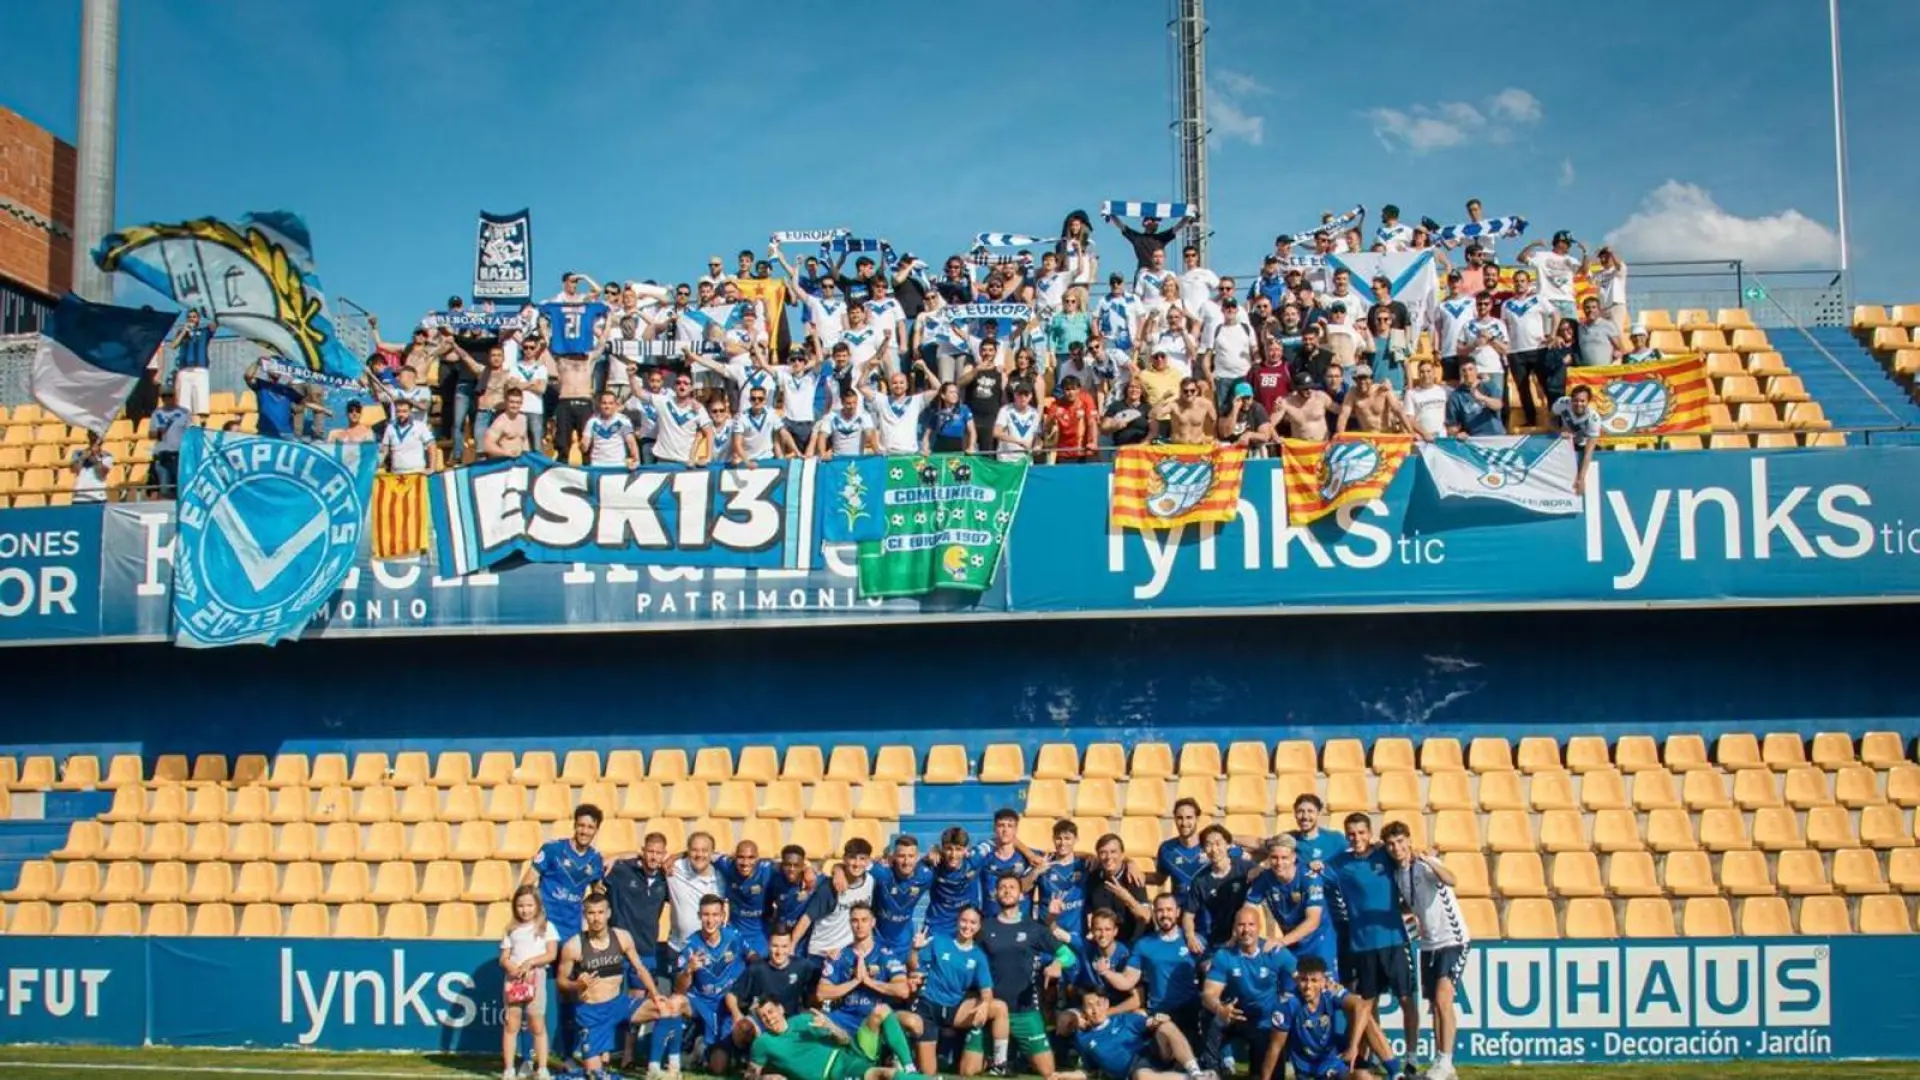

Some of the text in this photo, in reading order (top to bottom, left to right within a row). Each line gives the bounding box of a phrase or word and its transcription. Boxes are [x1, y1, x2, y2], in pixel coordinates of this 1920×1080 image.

[966, 304, 1033, 318] EUROPA
[474, 465, 780, 550] ESK13
[1583, 458, 1875, 590] lynks
[1397, 529, 1446, 565] tic
[281, 947, 477, 1046] lynks
[1378, 957, 1821, 1017] UHAUS
[1470, 1029, 1831, 1057] Reformas Decoración Jardín
